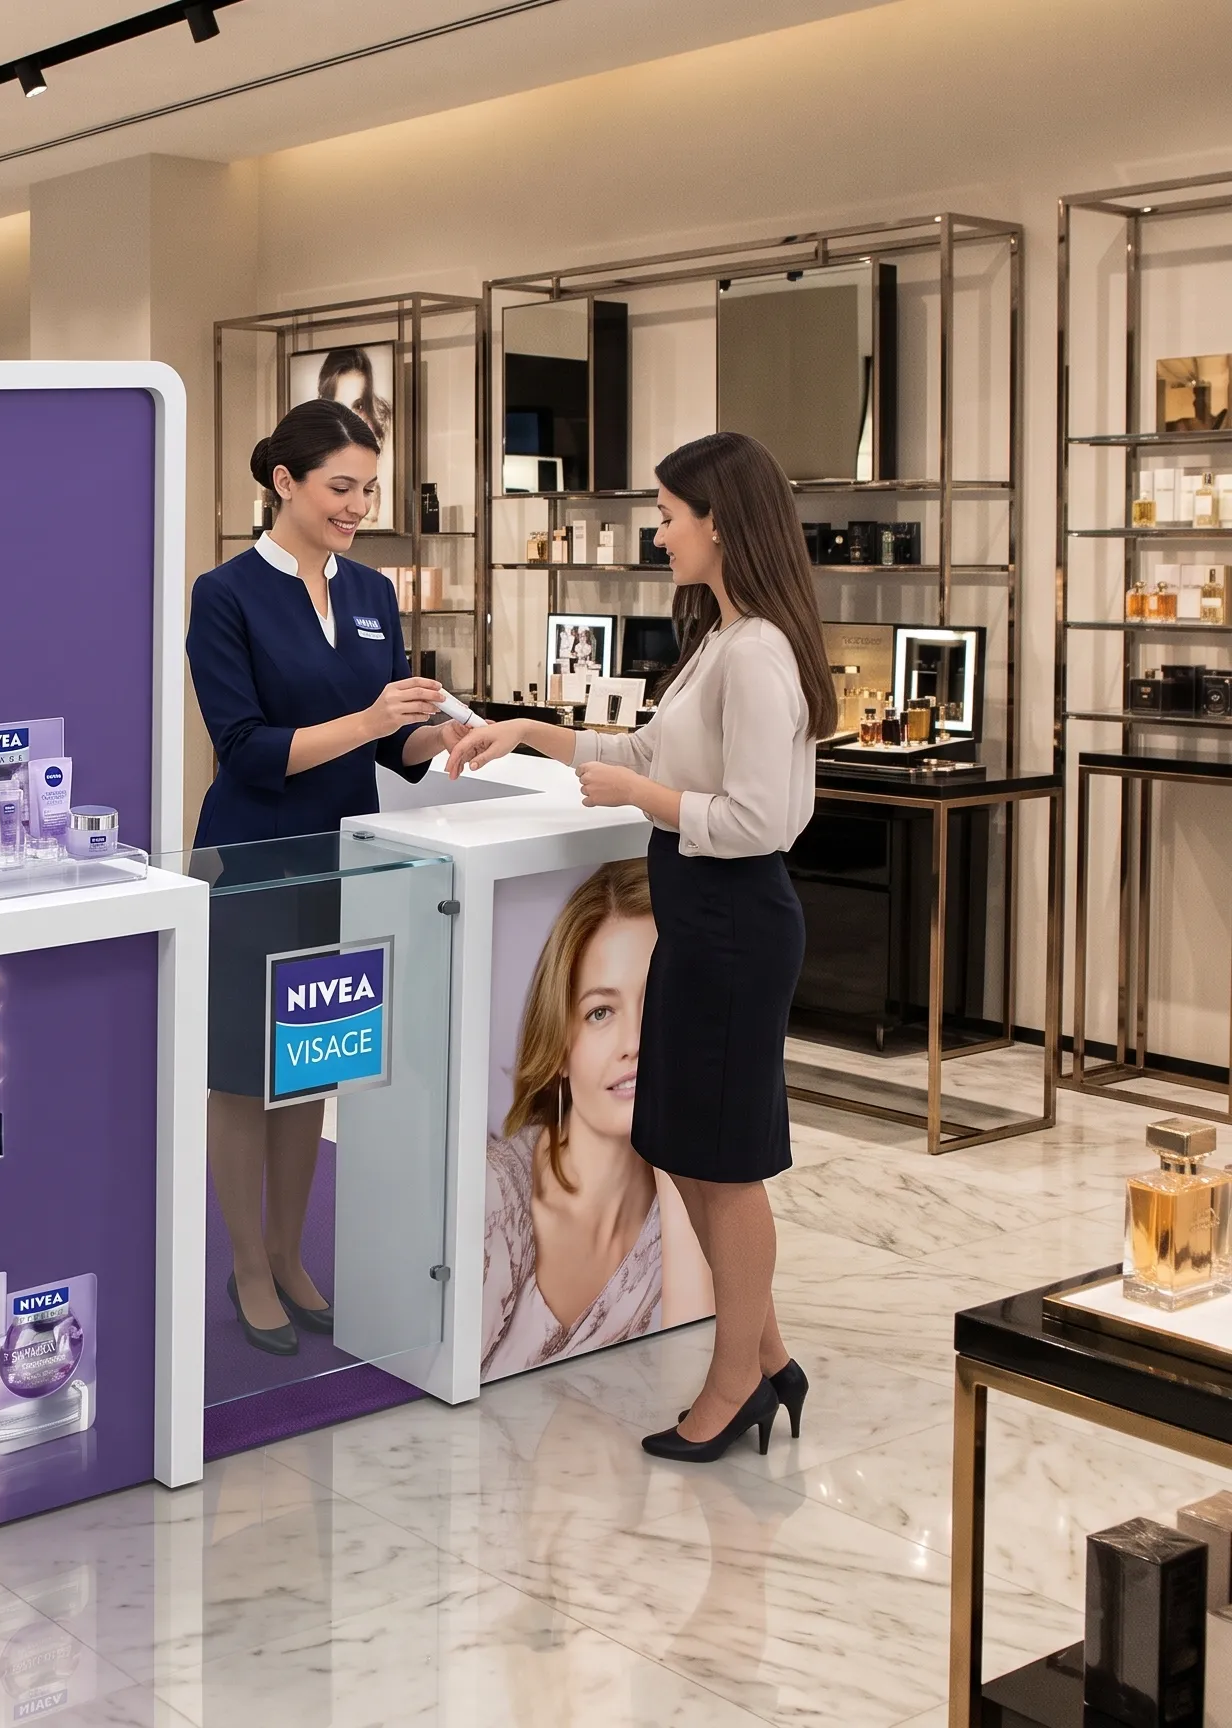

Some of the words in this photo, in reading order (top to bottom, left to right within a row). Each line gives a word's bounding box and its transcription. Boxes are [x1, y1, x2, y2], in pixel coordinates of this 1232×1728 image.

[287, 972, 375, 1012] NIVEA
[287, 1028, 373, 1066] VISAGE
[19, 1292, 63, 1312] NIVEA
